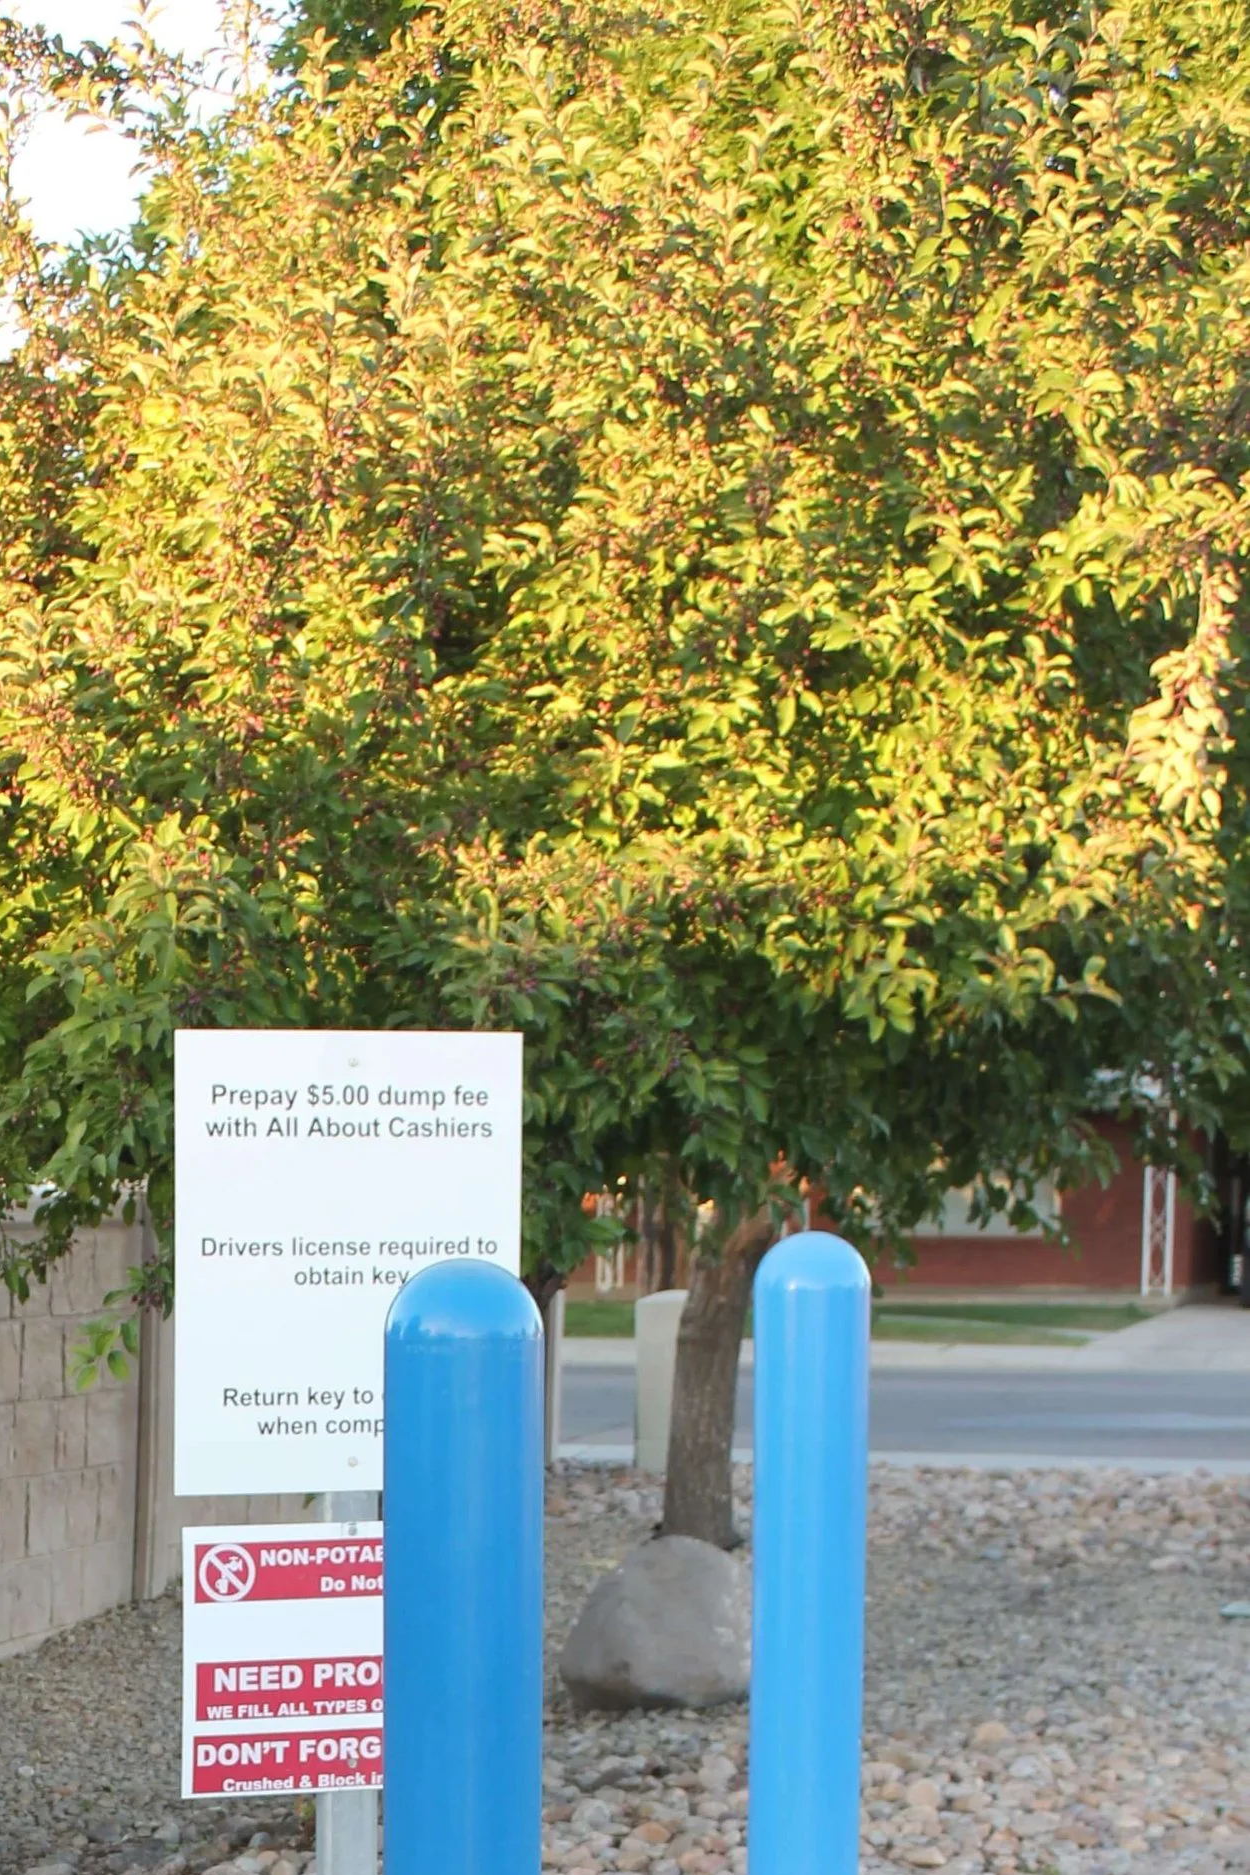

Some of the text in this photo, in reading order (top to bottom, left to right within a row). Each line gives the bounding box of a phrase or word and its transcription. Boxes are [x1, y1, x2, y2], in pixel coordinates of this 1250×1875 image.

[211, 1083, 489, 1111] Prepay $5.00 dump fee
[205, 1116, 493, 1138] with All About Cashiers
[201, 1236, 499, 1260] Drivers license required to
[293, 1265, 410, 1289] obtain key
[223, 1387, 299, 1407] Return
[307, 1386, 346, 1410] key
[352, 1387, 374, 1405] to
[257, 1416, 317, 1436] when
[320, 1575, 346, 1592] Do
[214, 1661, 384, 1693] NEED PRO
[207, 1705, 233, 1719] WE
[237, 1704, 274, 1718] FILL
[277, 1702, 309, 1716] ALL
[313, 1698, 367, 1714] TYPES
[197, 1736, 382, 1767] DON'T FORG
[222, 1775, 294, 1792] Crushed
[299, 1774, 312, 1788] &
[318, 1771, 366, 1787] Block
